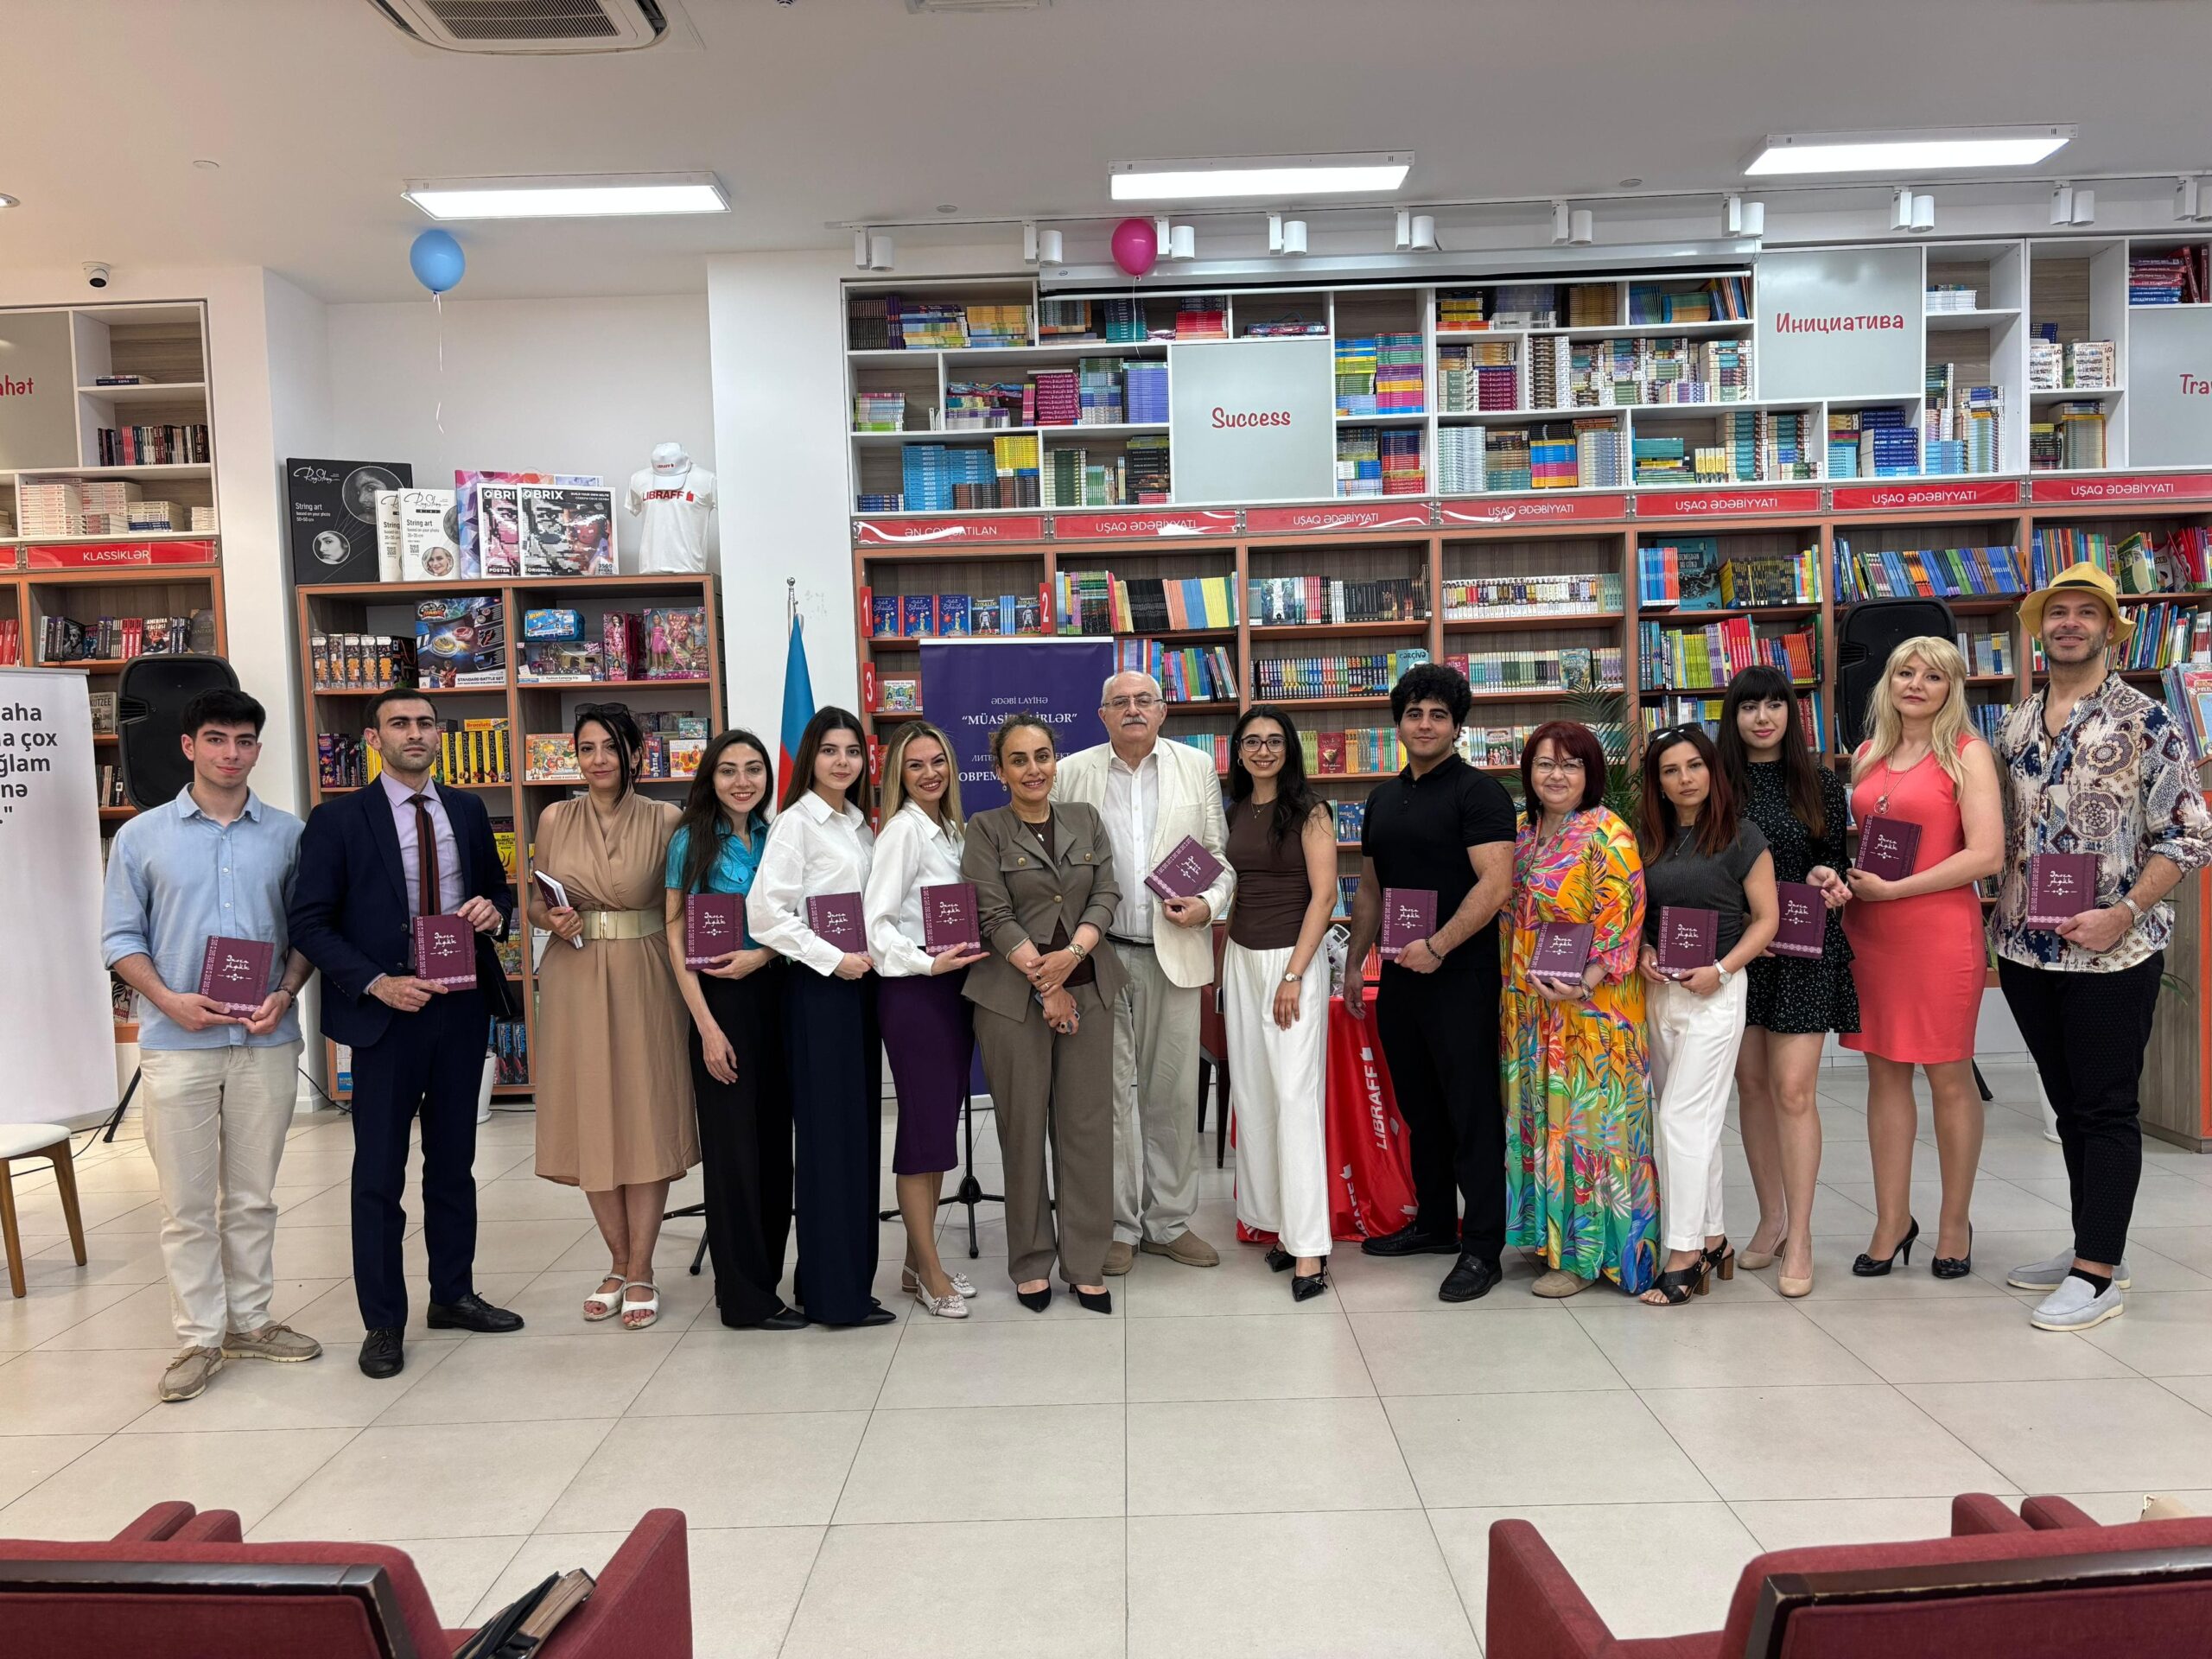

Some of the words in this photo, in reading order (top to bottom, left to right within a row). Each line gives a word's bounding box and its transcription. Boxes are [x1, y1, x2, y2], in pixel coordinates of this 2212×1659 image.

[1776, 312, 1904, 334] Инициатива
[2179, 373, 2212, 395] Tra
[1211, 407, 1291, 429] Success
[642, 490, 684, 502] LIBRAFF
[1872, 493, 1904, 505] UŞAQ
[1907, 489, 1977, 503] ƏDƏBİYYATI
[2071, 485, 2103, 498] UŞAQ
[2106, 481, 2175, 495] ƏDƏBİYYATI
[296, 502, 313, 512] String
[1518, 502, 1574, 516] ƏDƏBİYYATI
[1675, 500, 1707, 513] UŞAQ
[1710, 497, 1777, 510] ƏDƏBİYYATI
[406, 518, 423, 527] String
[1294, 514, 1321, 526] UŞAQ
[1323, 512, 1379, 524] ƏDƏBİYYATI
[1096, 522, 1127, 534] UŞAQ
[83, 548, 149, 562] KLASSİKLƏR
[863, 595, 869, 626] 1
[1042, 592, 1050, 623] 2
[867, 671, 873, 702] 3
[990, 696, 1017, 705] ƏDƏBİ
[1018, 695, 1048, 704] LAYİHƏ
[22, 733, 58, 751] çox
[651, 752, 659, 778] Puzzle
[869, 745, 876, 775] 5
[1364, 1065, 1387, 1150] LIBRAFF
